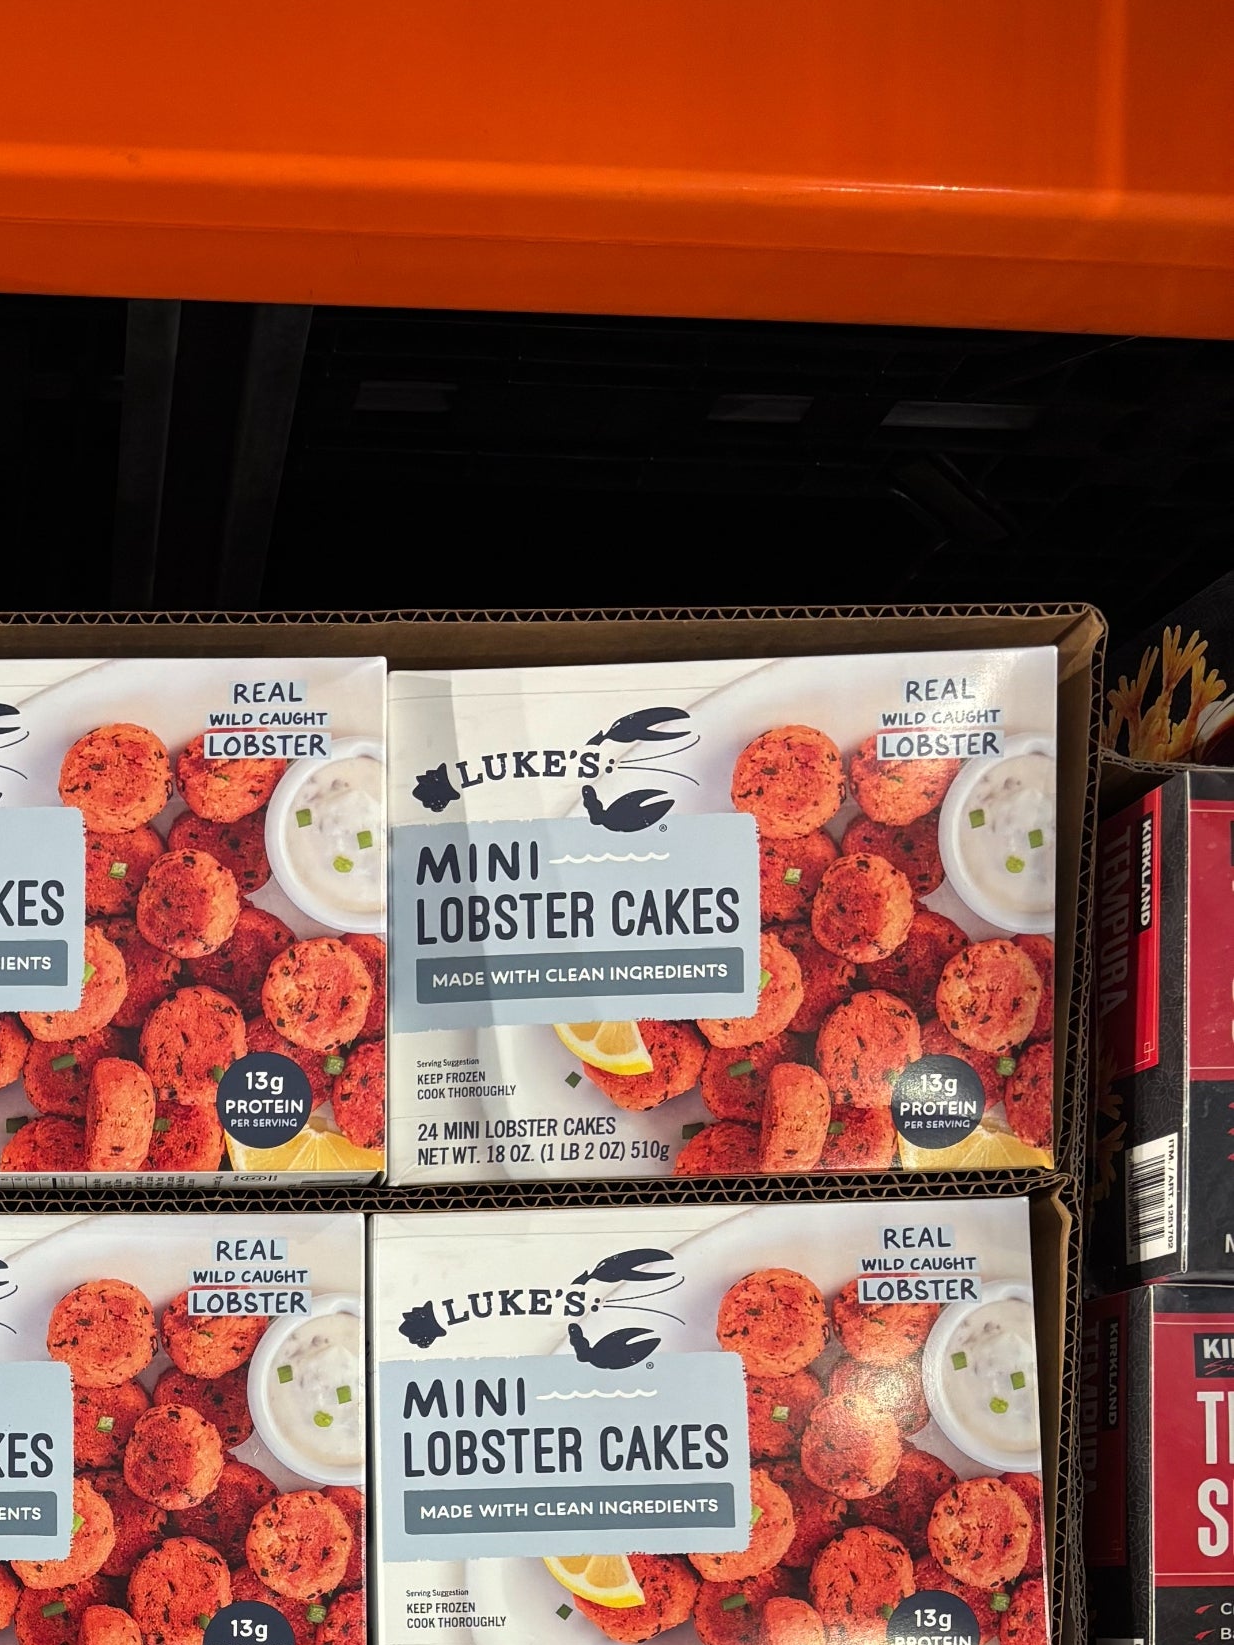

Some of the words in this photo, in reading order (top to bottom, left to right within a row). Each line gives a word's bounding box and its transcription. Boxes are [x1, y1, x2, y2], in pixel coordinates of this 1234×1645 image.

[233, 682, 302, 704] REAL
[209, 713, 252, 726] WILD
[259, 712, 328, 726] CAUGHT
[208, 733, 326, 756] LOBSTER
[417, 840, 538, 885] MINI
[1140, 818, 1153, 927] KIRKLAND
[418, 892, 594, 944] LOBSTER
[612, 887, 740, 938] CAKES
[1099, 824, 1133, 1020] TEMPURA
[418, 1124, 438, 1141] 24
[444, 1122, 479, 1140] MINI
[485, 1119, 557, 1138] LOBSTER
[563, 1118, 616, 1136] CAKES
[1108, 1322, 1119, 1426] KIRKLAND
[403, 1377, 526, 1419] MINI
[404, 1428, 583, 1477] LOBSTER
[600, 1424, 730, 1471] CAKES
